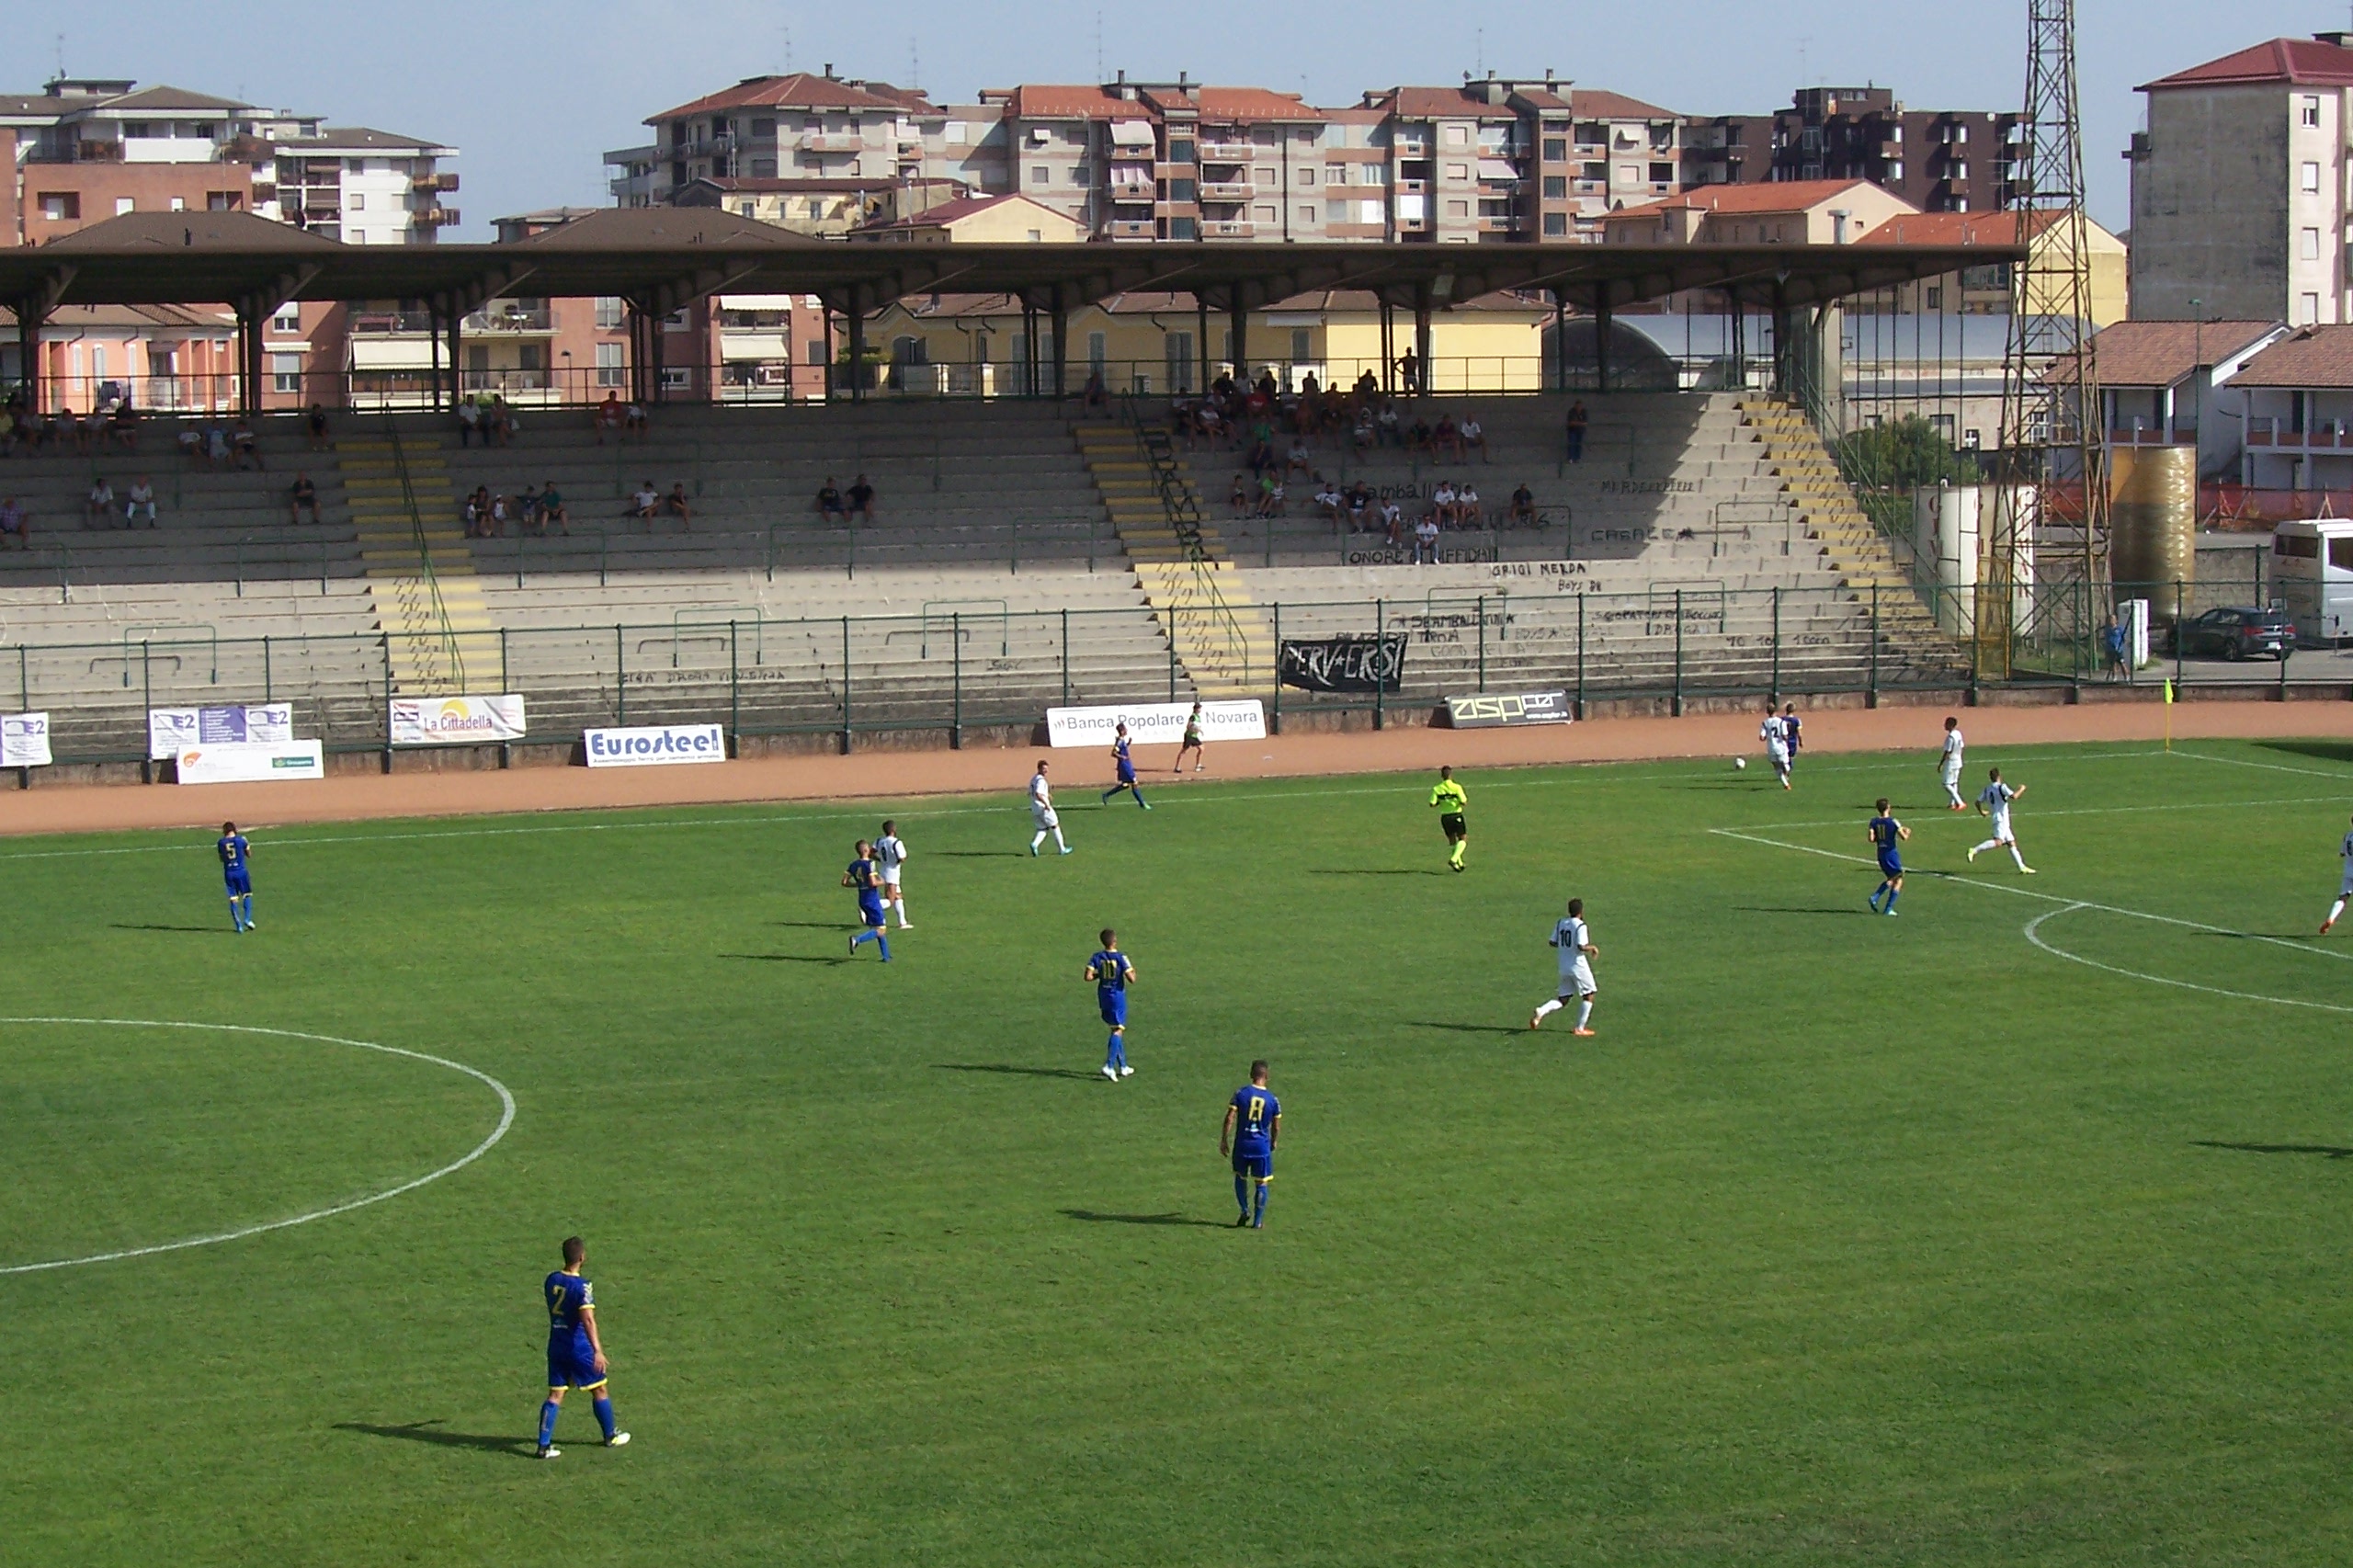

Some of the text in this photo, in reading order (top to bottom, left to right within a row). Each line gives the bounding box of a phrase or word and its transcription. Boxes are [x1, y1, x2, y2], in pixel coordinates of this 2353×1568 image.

[1348, 550, 1404, 564] ONORE
[1491, 562, 1586, 577] GRIGI MERDA
[423, 717, 438, 733] La
[440, 713, 493, 732] Cittadella
[1066, 710, 1258, 731] Banca Popolare Novara
[591, 728, 720, 756] Eurosteel
[225, 842, 237, 859] 5
[1559, 929, 1573, 949] 10
[552, 1285, 567, 1316] 2
